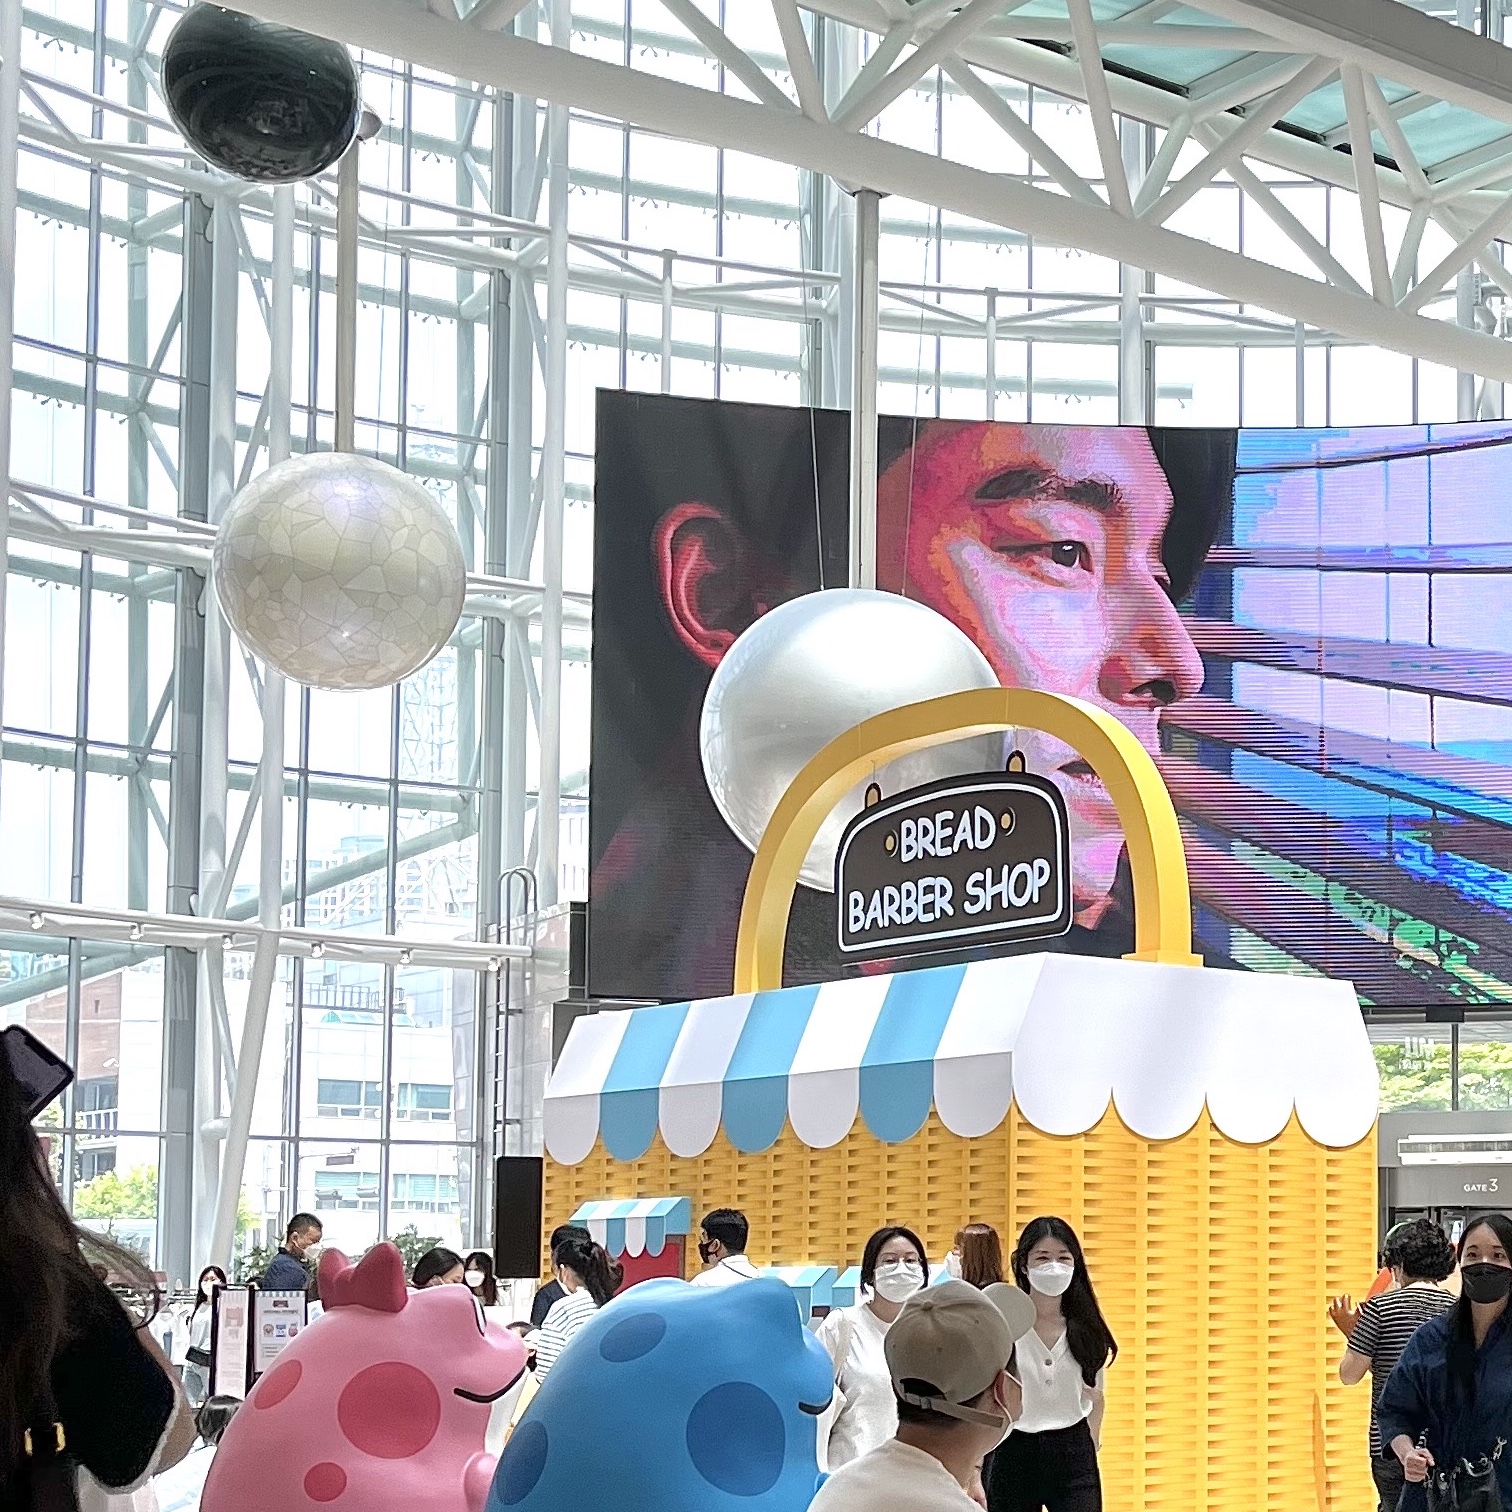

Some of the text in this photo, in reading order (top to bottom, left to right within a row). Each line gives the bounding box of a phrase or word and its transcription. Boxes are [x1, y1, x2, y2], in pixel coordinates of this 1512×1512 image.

[900, 805, 996, 863] BREAD
[848, 857, 1051, 934] BARBER SHOP
[1463, 1178, 1499, 1192] GATE 3
